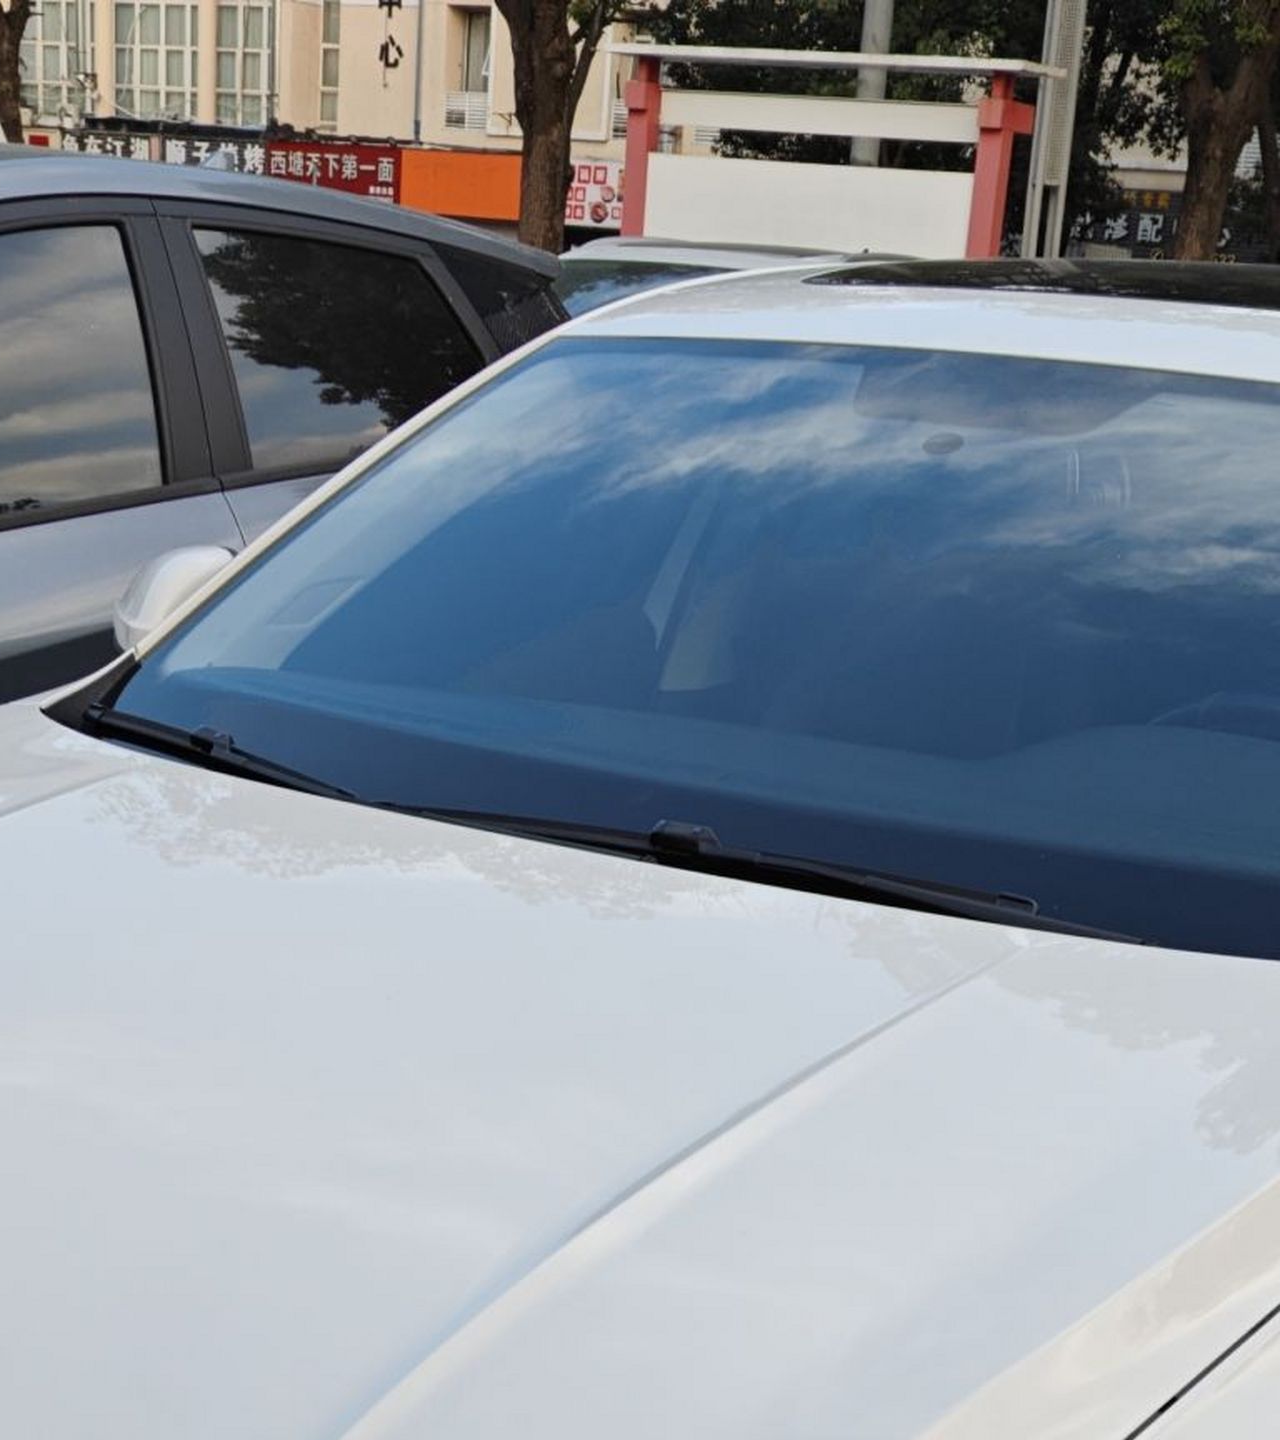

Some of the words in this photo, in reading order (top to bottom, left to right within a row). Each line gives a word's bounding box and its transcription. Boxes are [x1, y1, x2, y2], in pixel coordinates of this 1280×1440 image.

[269, 150, 395, 184] 西塘天下第一面
